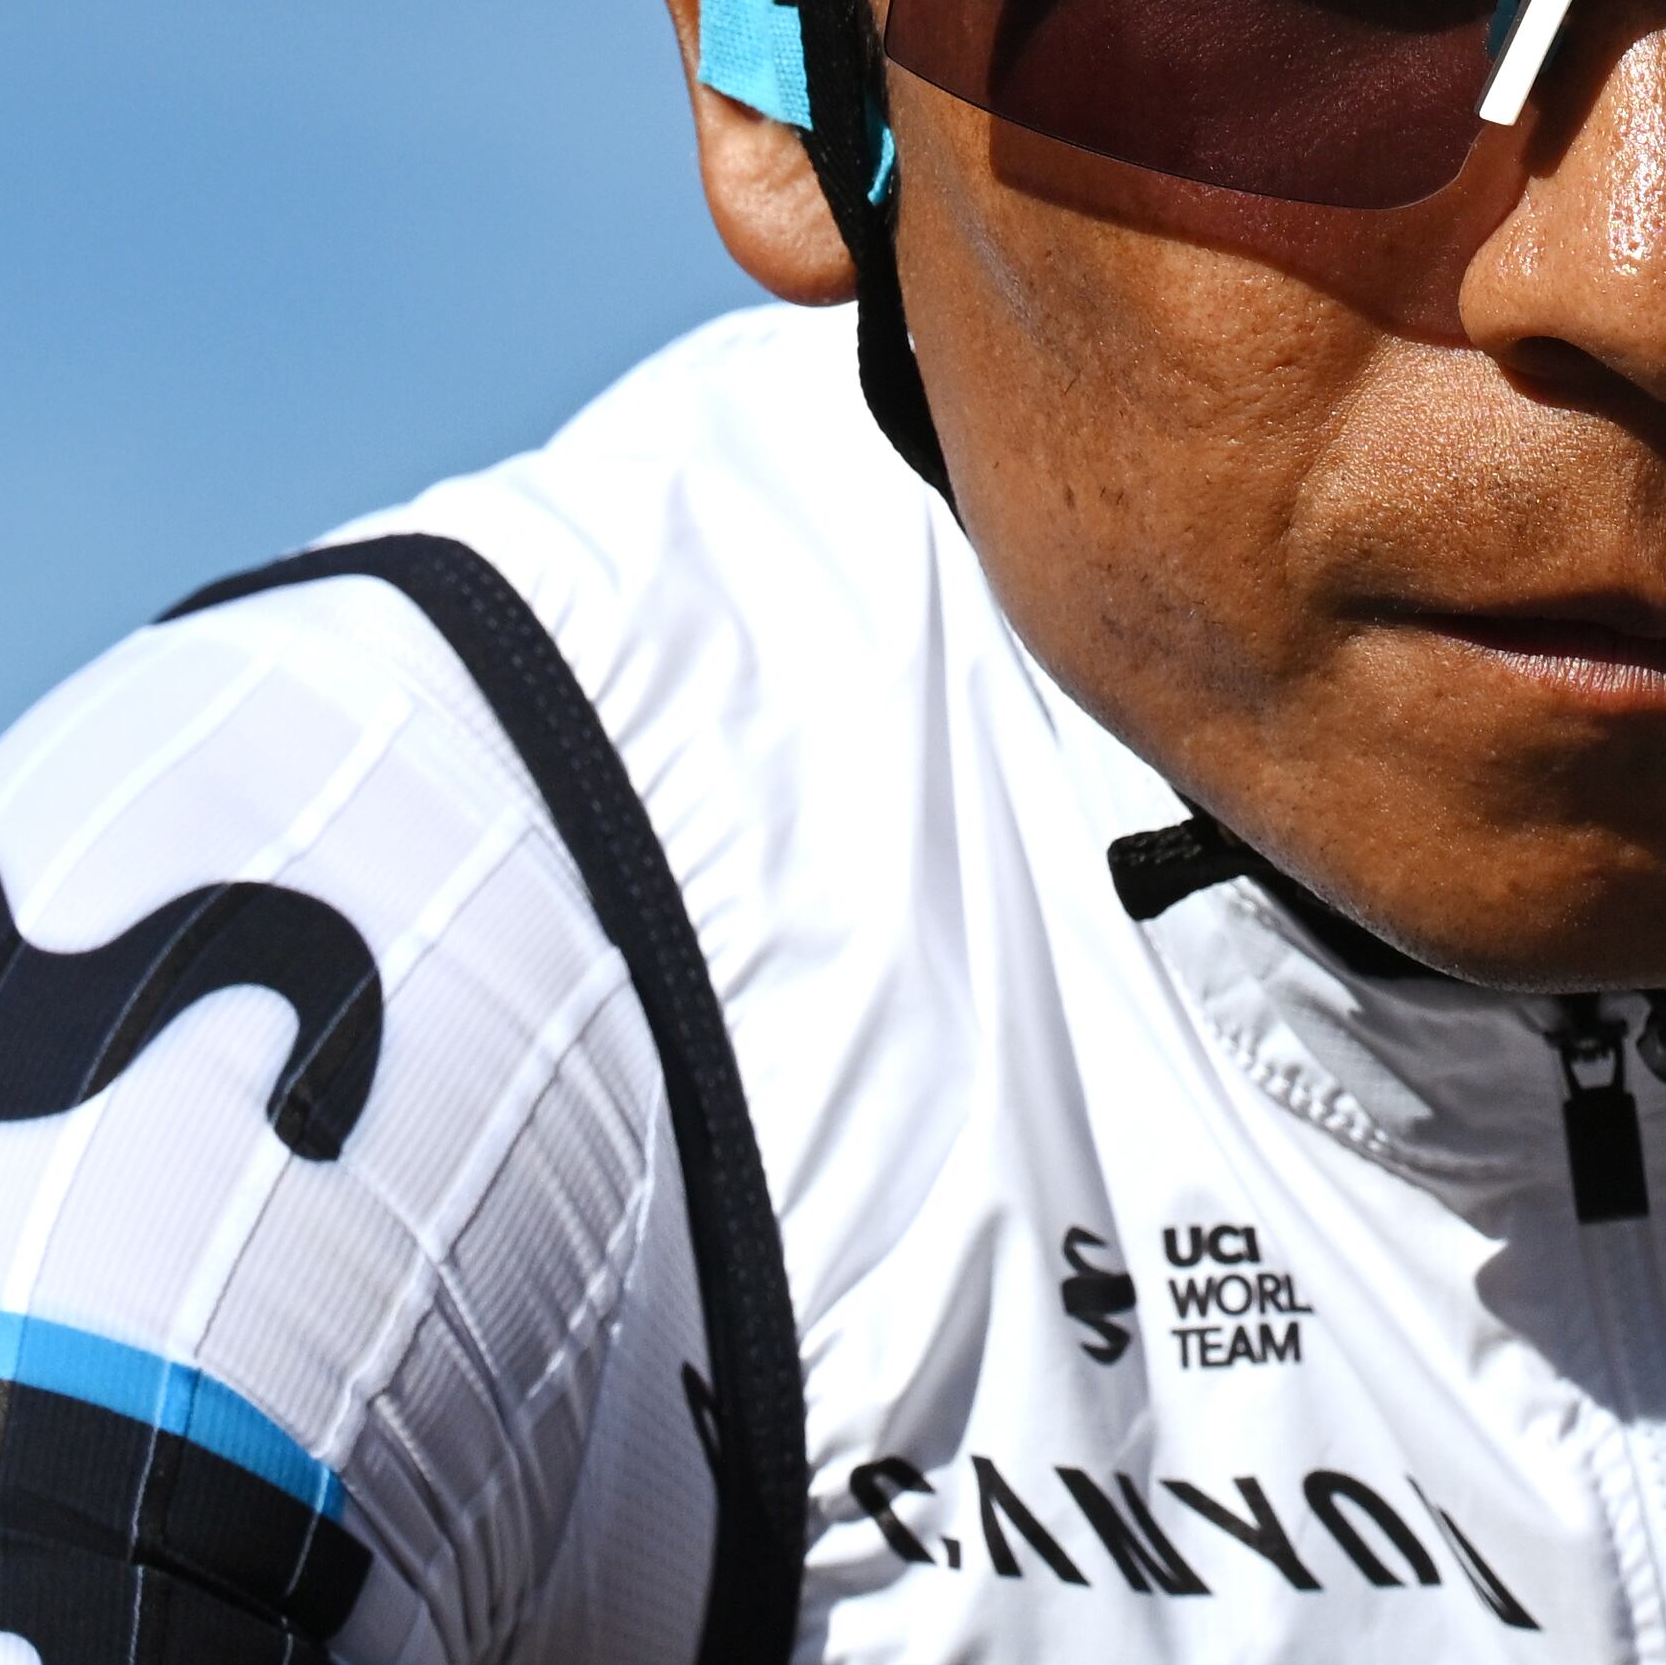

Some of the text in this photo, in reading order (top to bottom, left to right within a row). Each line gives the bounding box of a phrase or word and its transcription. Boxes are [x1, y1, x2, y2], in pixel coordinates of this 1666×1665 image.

[1162, 1223, 1262, 1268] UCI
[1168, 1272, 1315, 1320] WORL
[1170, 1321, 1303, 1371] TEAM
